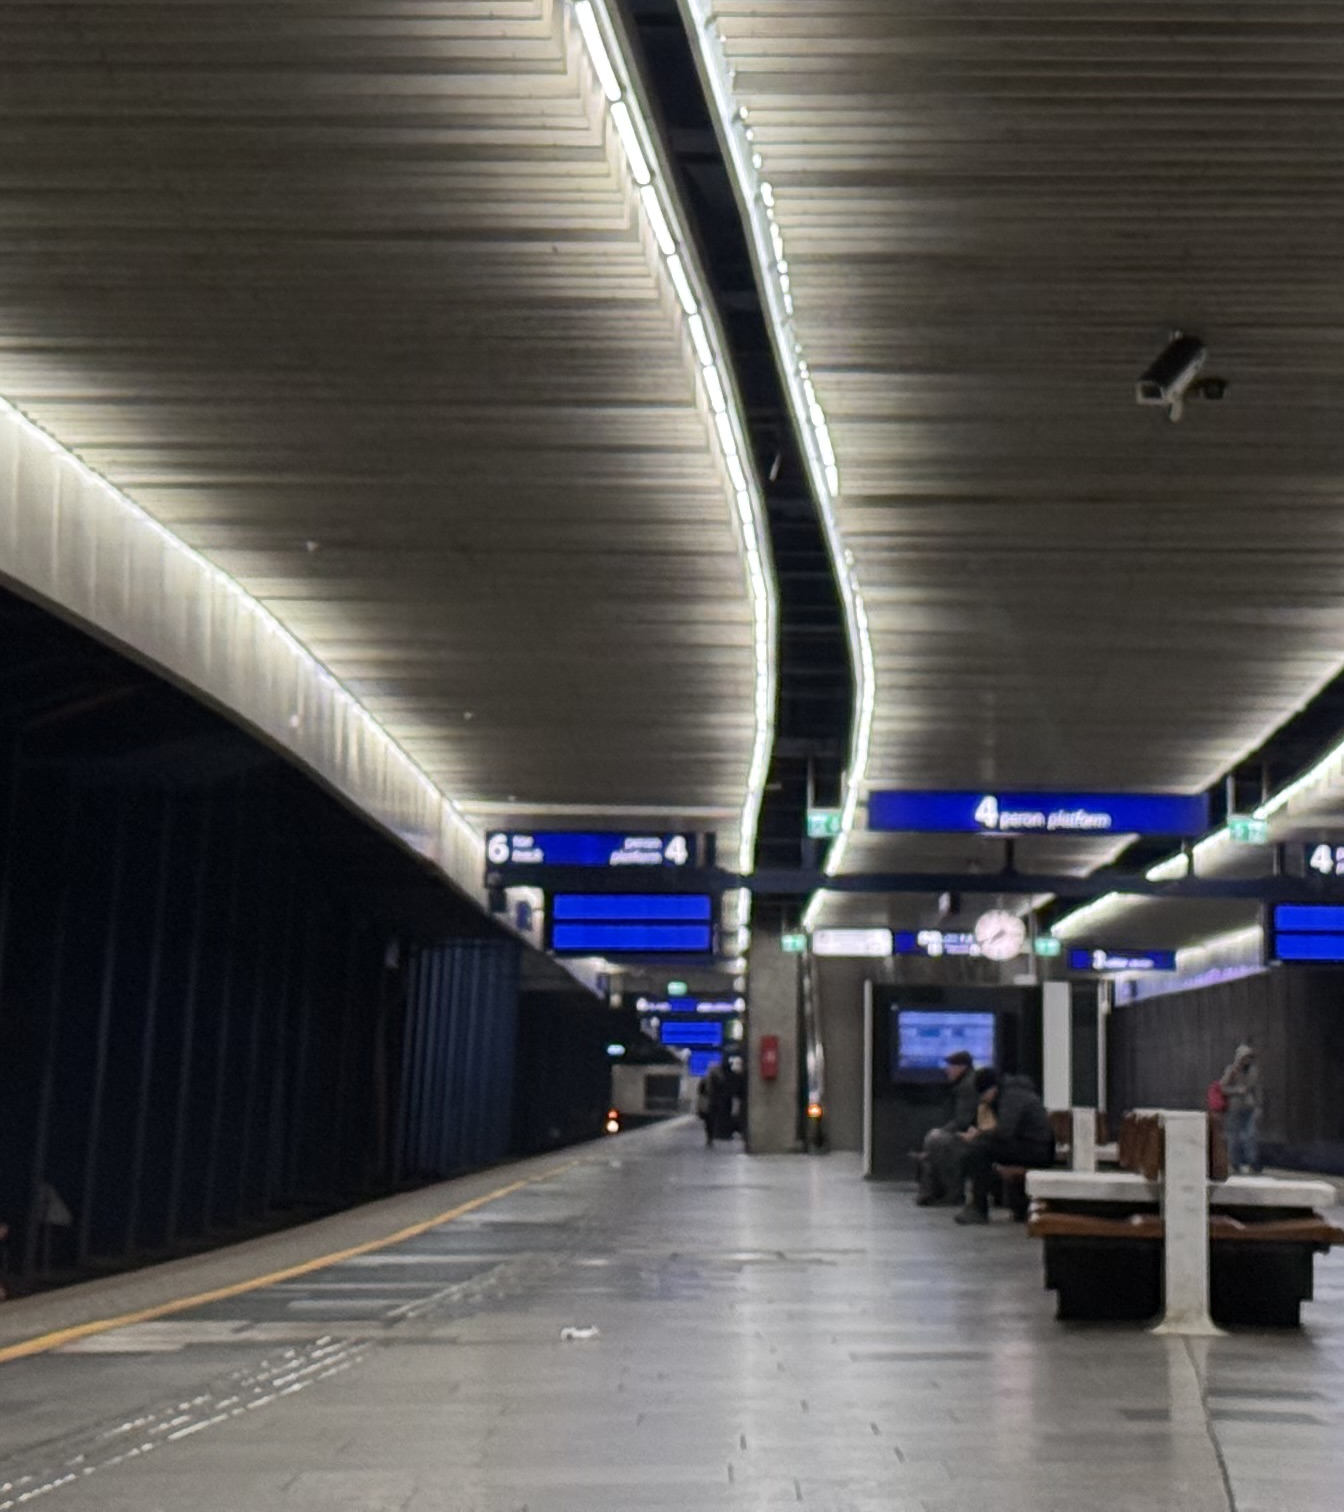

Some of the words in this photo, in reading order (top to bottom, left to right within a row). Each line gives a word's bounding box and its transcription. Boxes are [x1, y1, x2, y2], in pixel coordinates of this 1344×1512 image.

[975, 795, 998, 828] 4
[1000, 811, 1045, 830] peron
[1047, 809, 1112, 831] platform
[488, 834, 509, 864] 6
[665, 836, 688, 865] 4
[1310, 844, 1333, 874] 4
